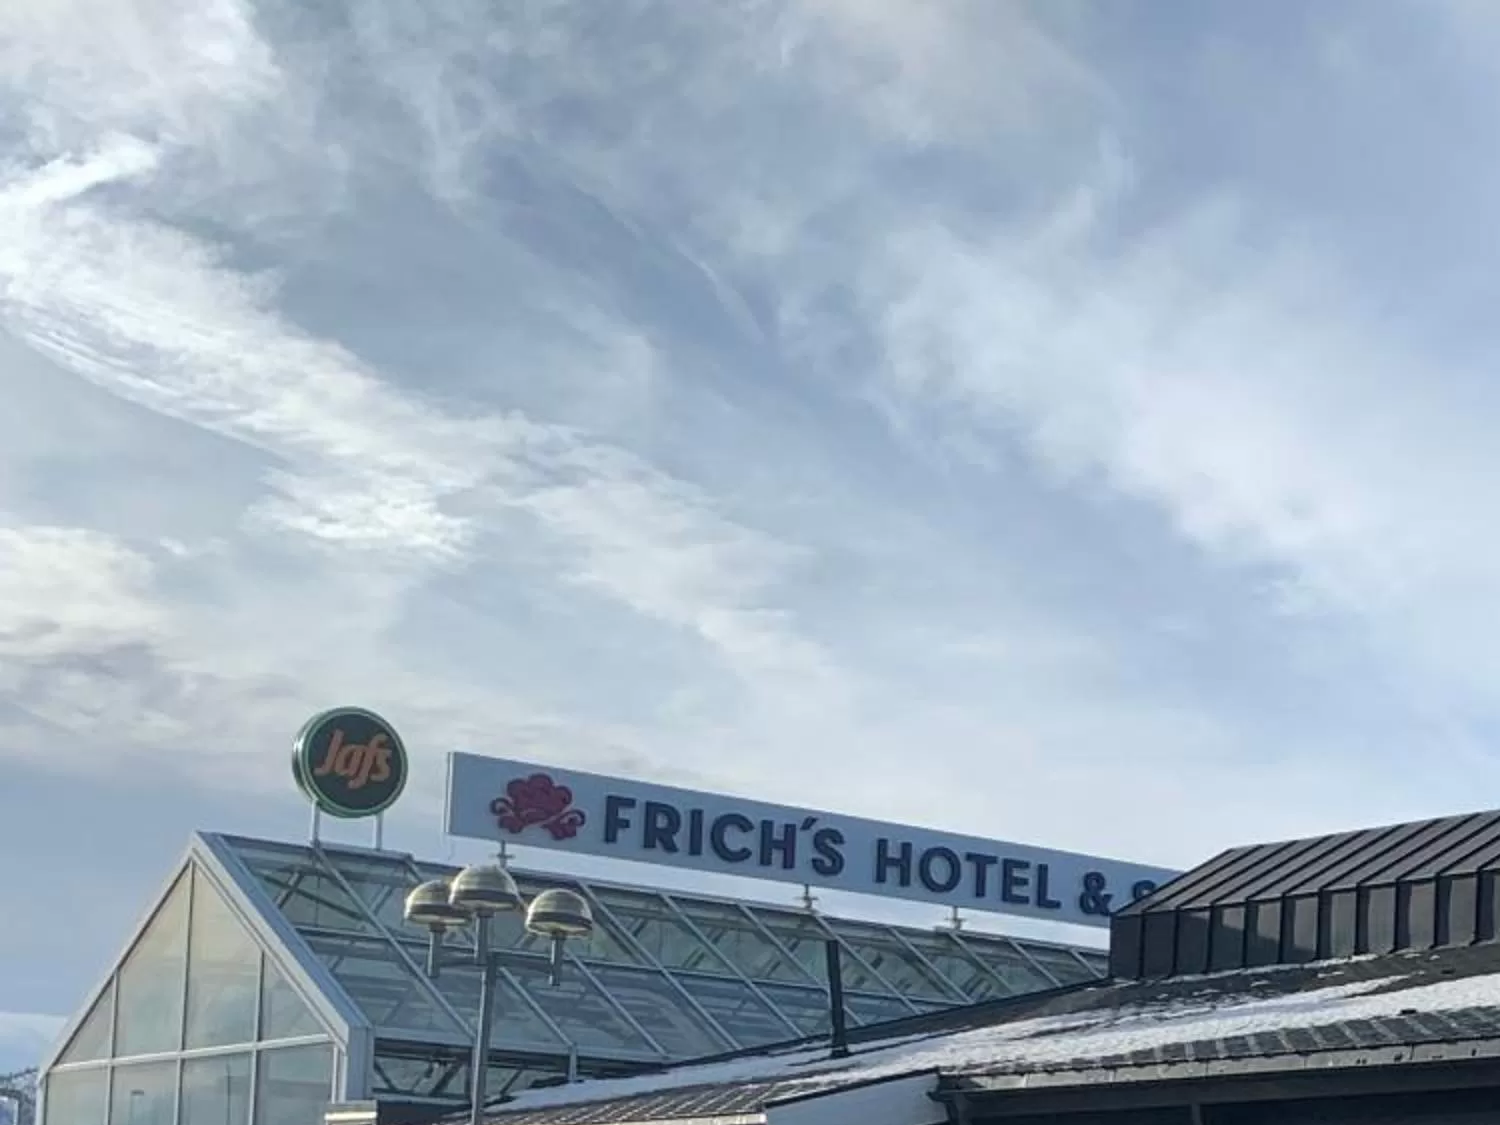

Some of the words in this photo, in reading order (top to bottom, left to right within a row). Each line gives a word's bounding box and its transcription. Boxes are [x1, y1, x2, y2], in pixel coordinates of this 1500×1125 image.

[314, 729, 393, 789] Jafs
[875, 838, 1061, 909] HOTEL
[1079, 871, 1113, 916] &
